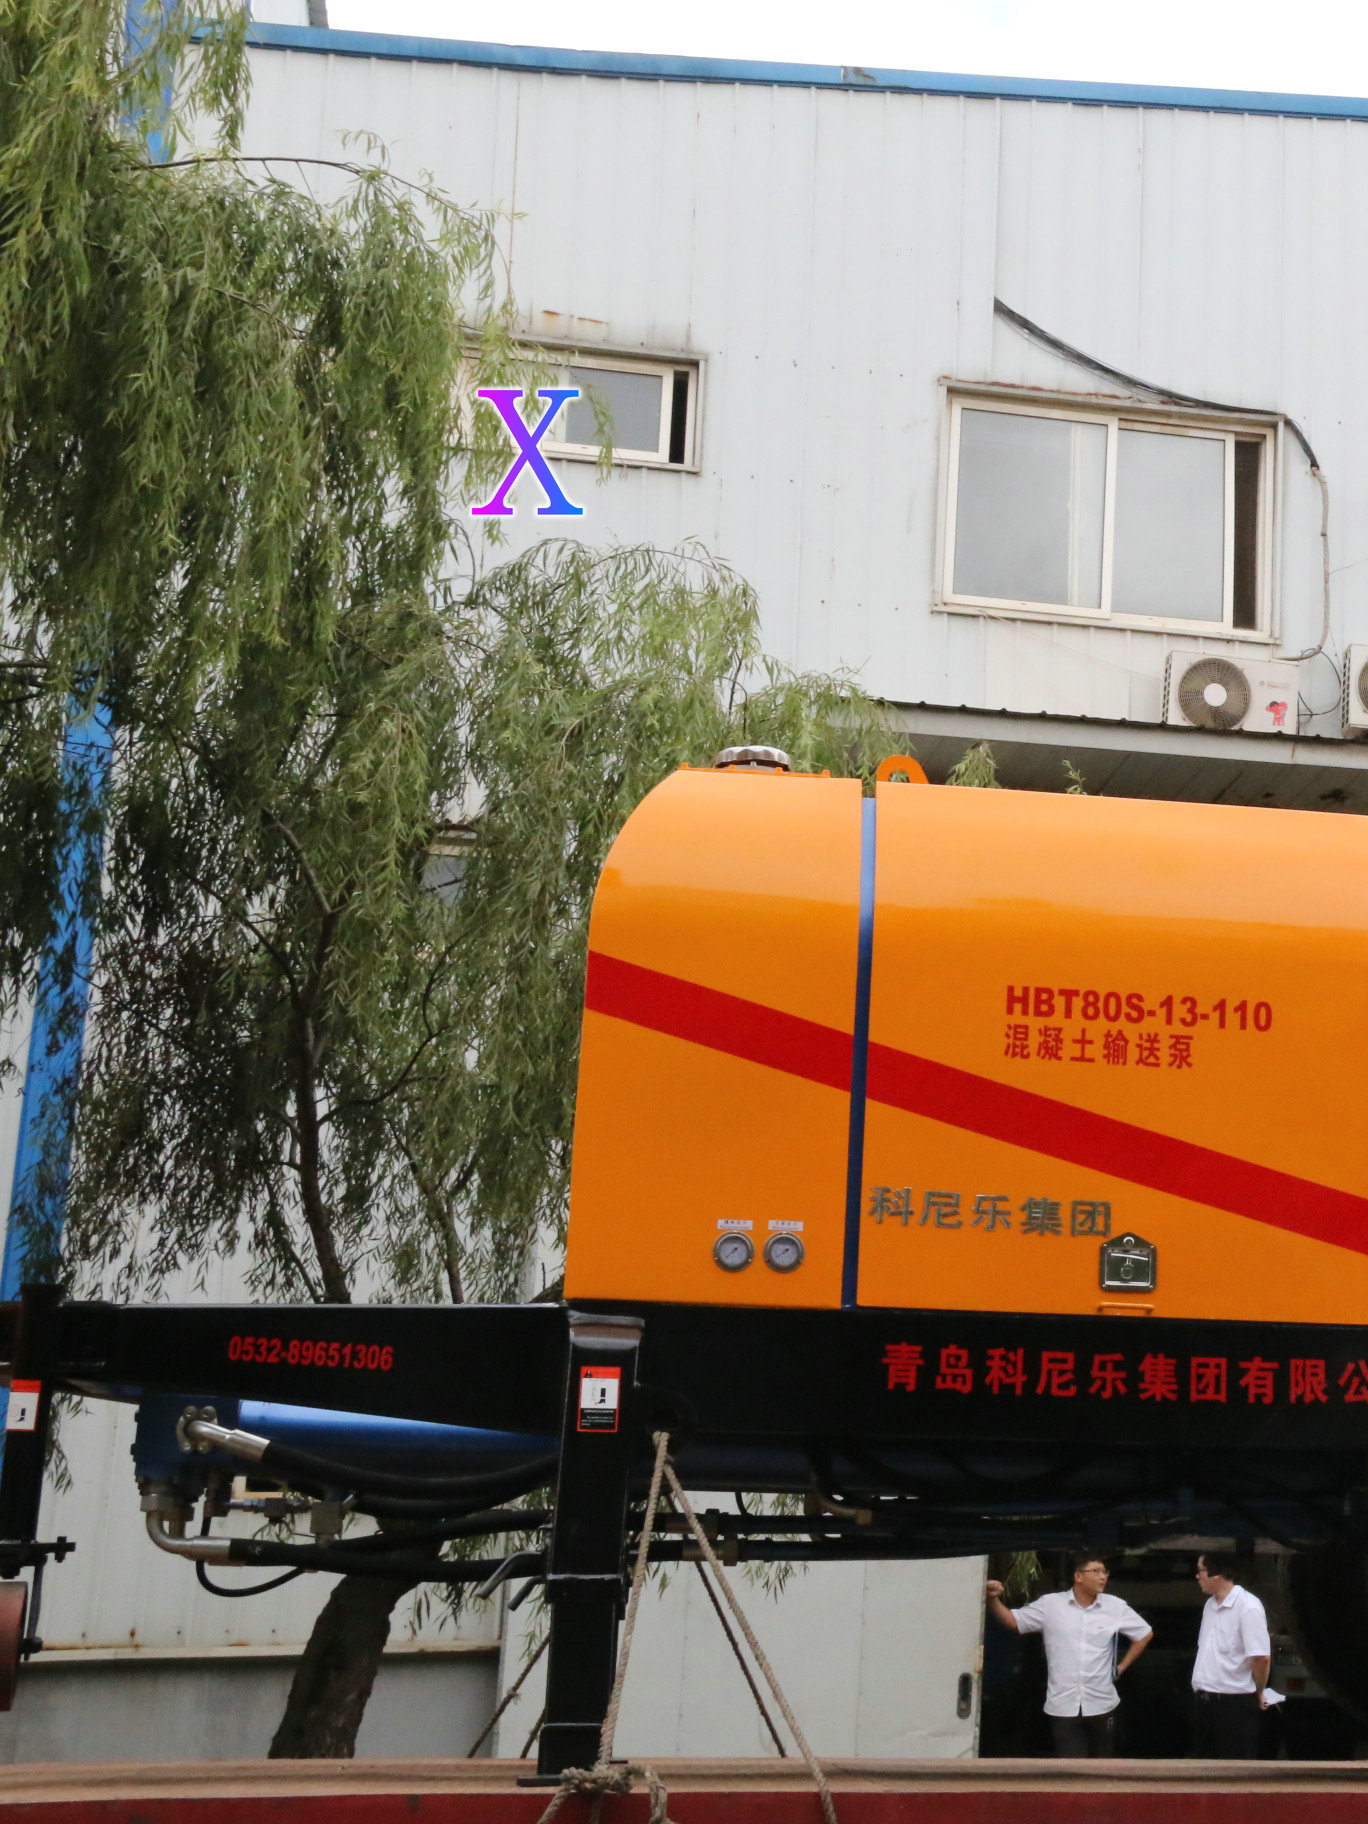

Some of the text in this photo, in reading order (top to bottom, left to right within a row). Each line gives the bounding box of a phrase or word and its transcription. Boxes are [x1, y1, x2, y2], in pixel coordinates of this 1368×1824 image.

[1005, 985, 1273, 1032] HBT80S-13-110
[1003, 1023, 1194, 1070] 混凝土输送泵
[868, 1186, 1112, 1238] 科尼乐集团
[227, 1335, 394, 1371] 0532-89651306
